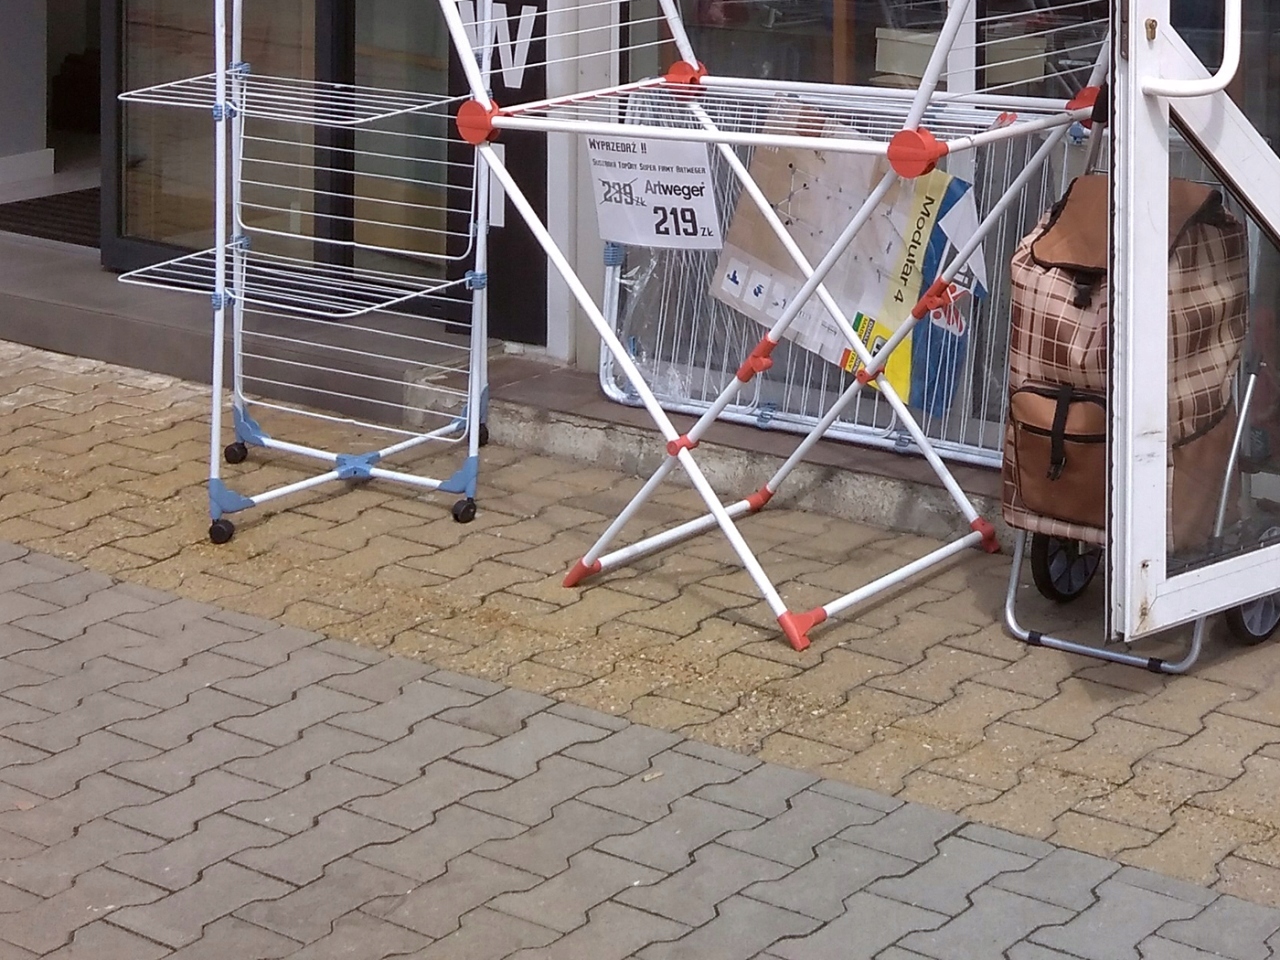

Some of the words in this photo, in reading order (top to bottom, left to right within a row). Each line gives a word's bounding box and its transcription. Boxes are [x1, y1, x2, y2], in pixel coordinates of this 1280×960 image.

[644, 179, 706, 200] Artweger
[653, 206, 698, 236] 219
[900, 195, 935, 287] Modular
[893, 289, 905, 303] 4
